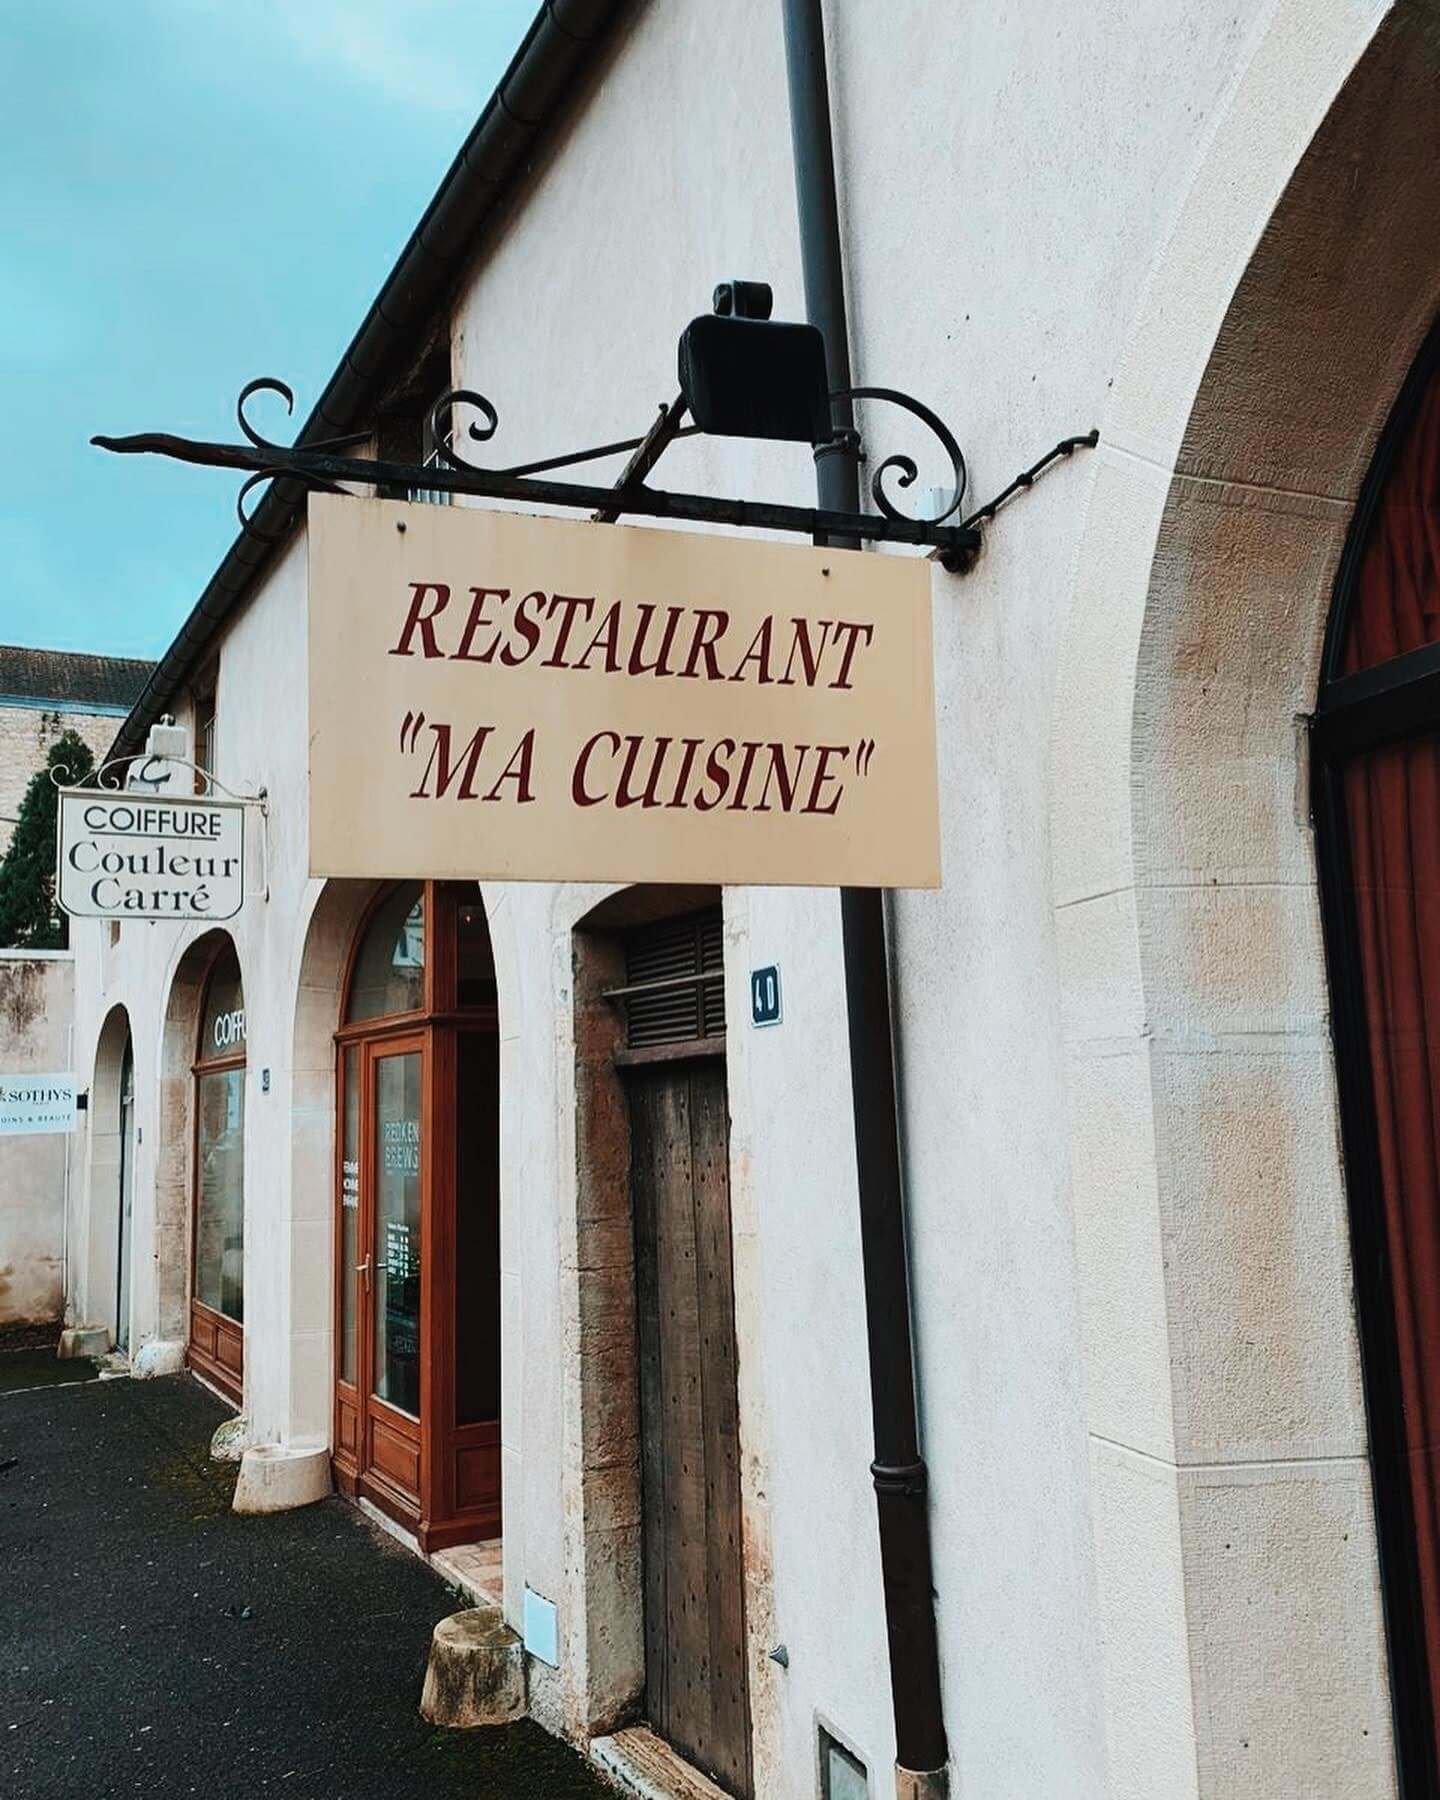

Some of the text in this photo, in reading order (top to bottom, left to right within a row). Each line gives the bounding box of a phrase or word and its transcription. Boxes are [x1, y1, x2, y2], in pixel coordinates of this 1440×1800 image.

[388, 582, 874, 690] RESTAURANT
[400, 711, 876, 816] "MA CUISINE"
[84, 806, 222, 837] COIFFURE
[68, 840, 240, 878] Couleur
[90, 877, 211, 912] Carré
[8, 1088, 72, 1103] SOTHYS
